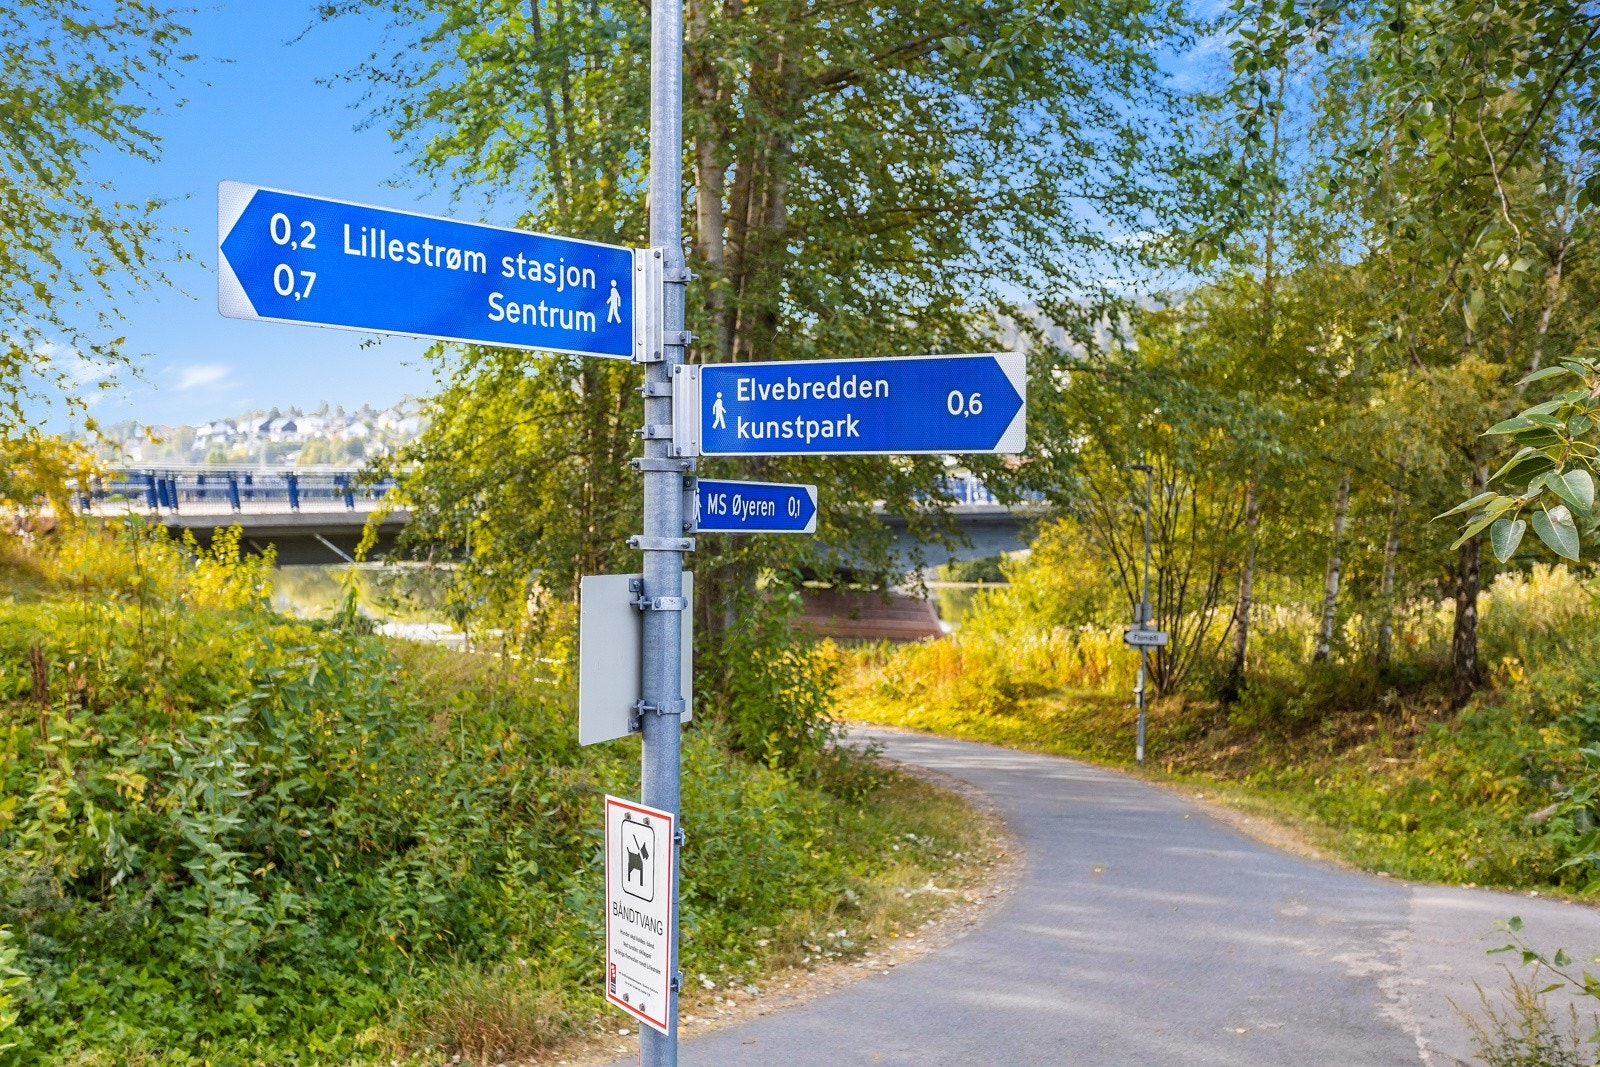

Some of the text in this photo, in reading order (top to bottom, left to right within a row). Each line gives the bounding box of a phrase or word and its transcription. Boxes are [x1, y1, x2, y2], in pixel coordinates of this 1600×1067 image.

[270, 213, 596, 293] 0,2 Lillestrøm stasjon
[273, 264, 596, 333] 0,7 Sentrum
[736, 374, 889, 402] Elvebredden
[947, 389, 983, 418] 0,6
[736, 414, 860, 444] kunstpark
[707, 493, 800, 522] MS Øyeren 0,1
[613, 900, 663, 935] BÅNDTVANG
